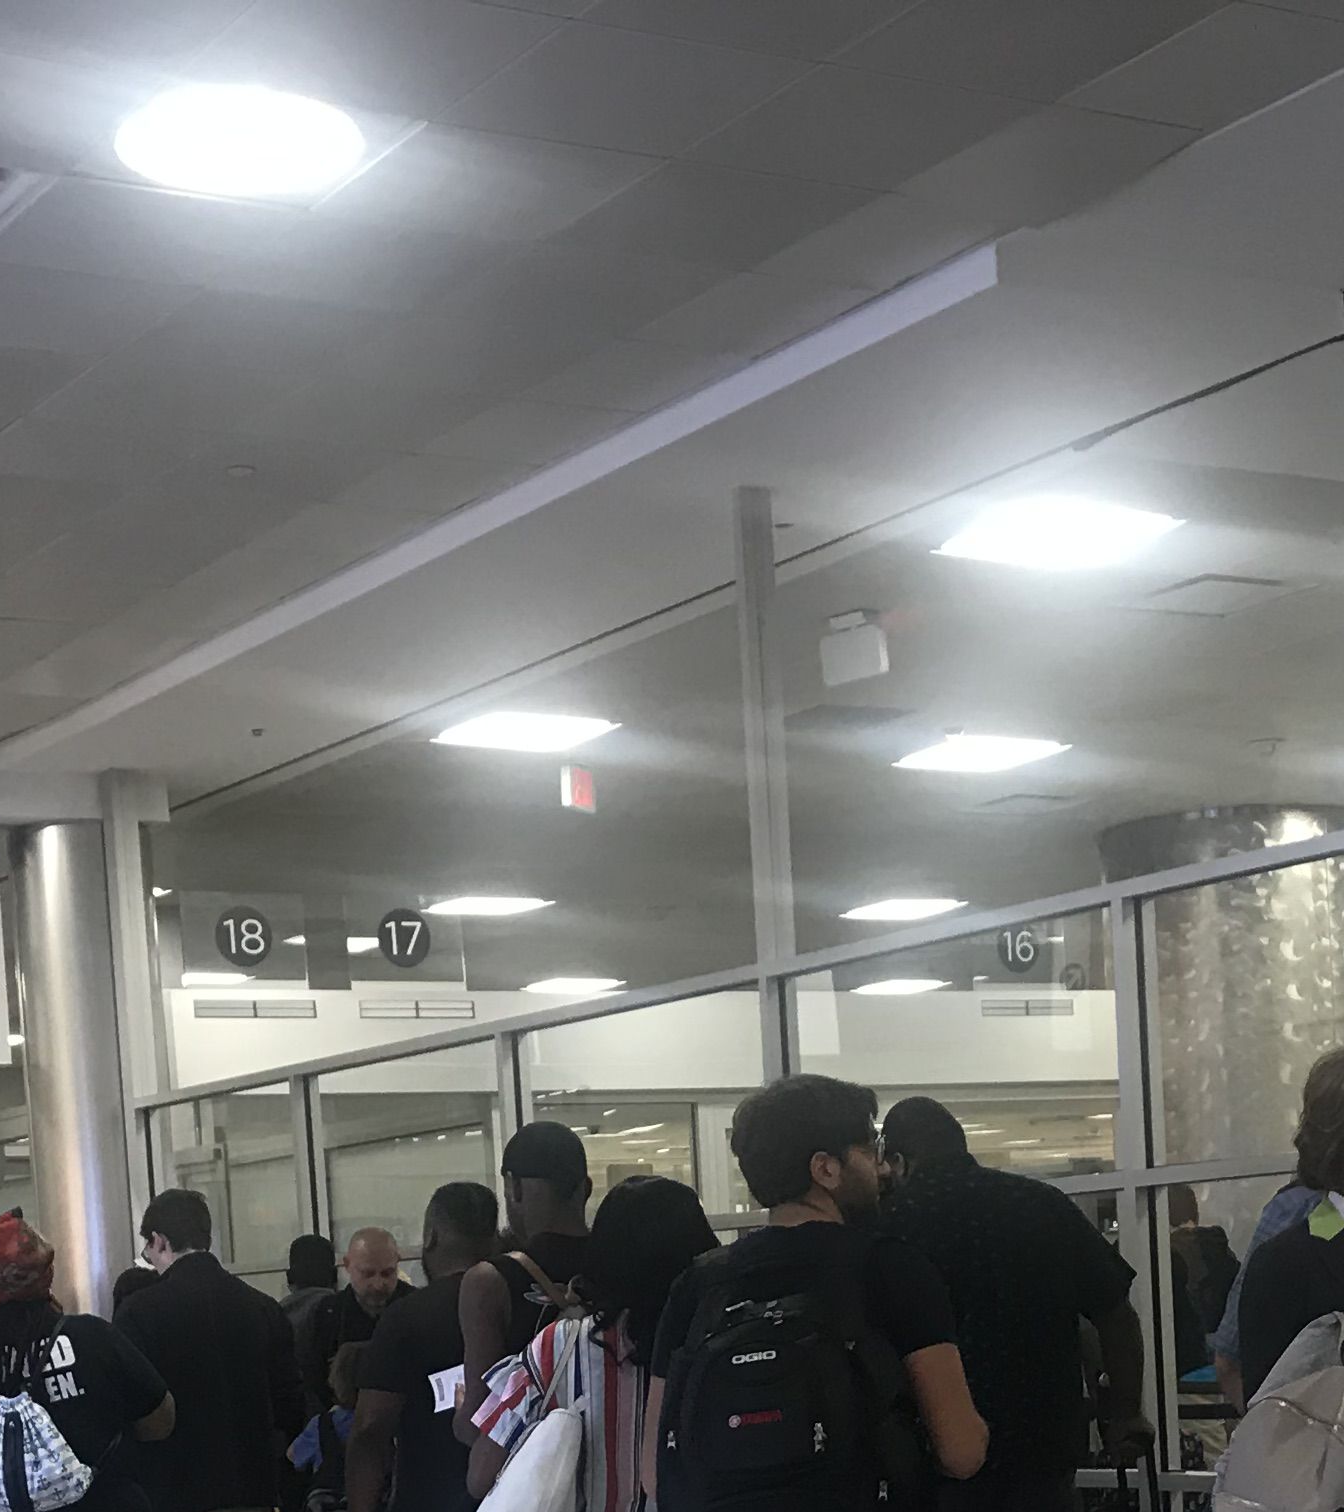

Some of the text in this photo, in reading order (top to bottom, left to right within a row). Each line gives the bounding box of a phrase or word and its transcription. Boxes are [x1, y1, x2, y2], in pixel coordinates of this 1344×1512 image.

[223, 918, 265, 955] 18
[384, 920, 422, 956] 17
[1003, 930, 1034, 962] 16
[731, 1350, 777, 1364] OGIO
